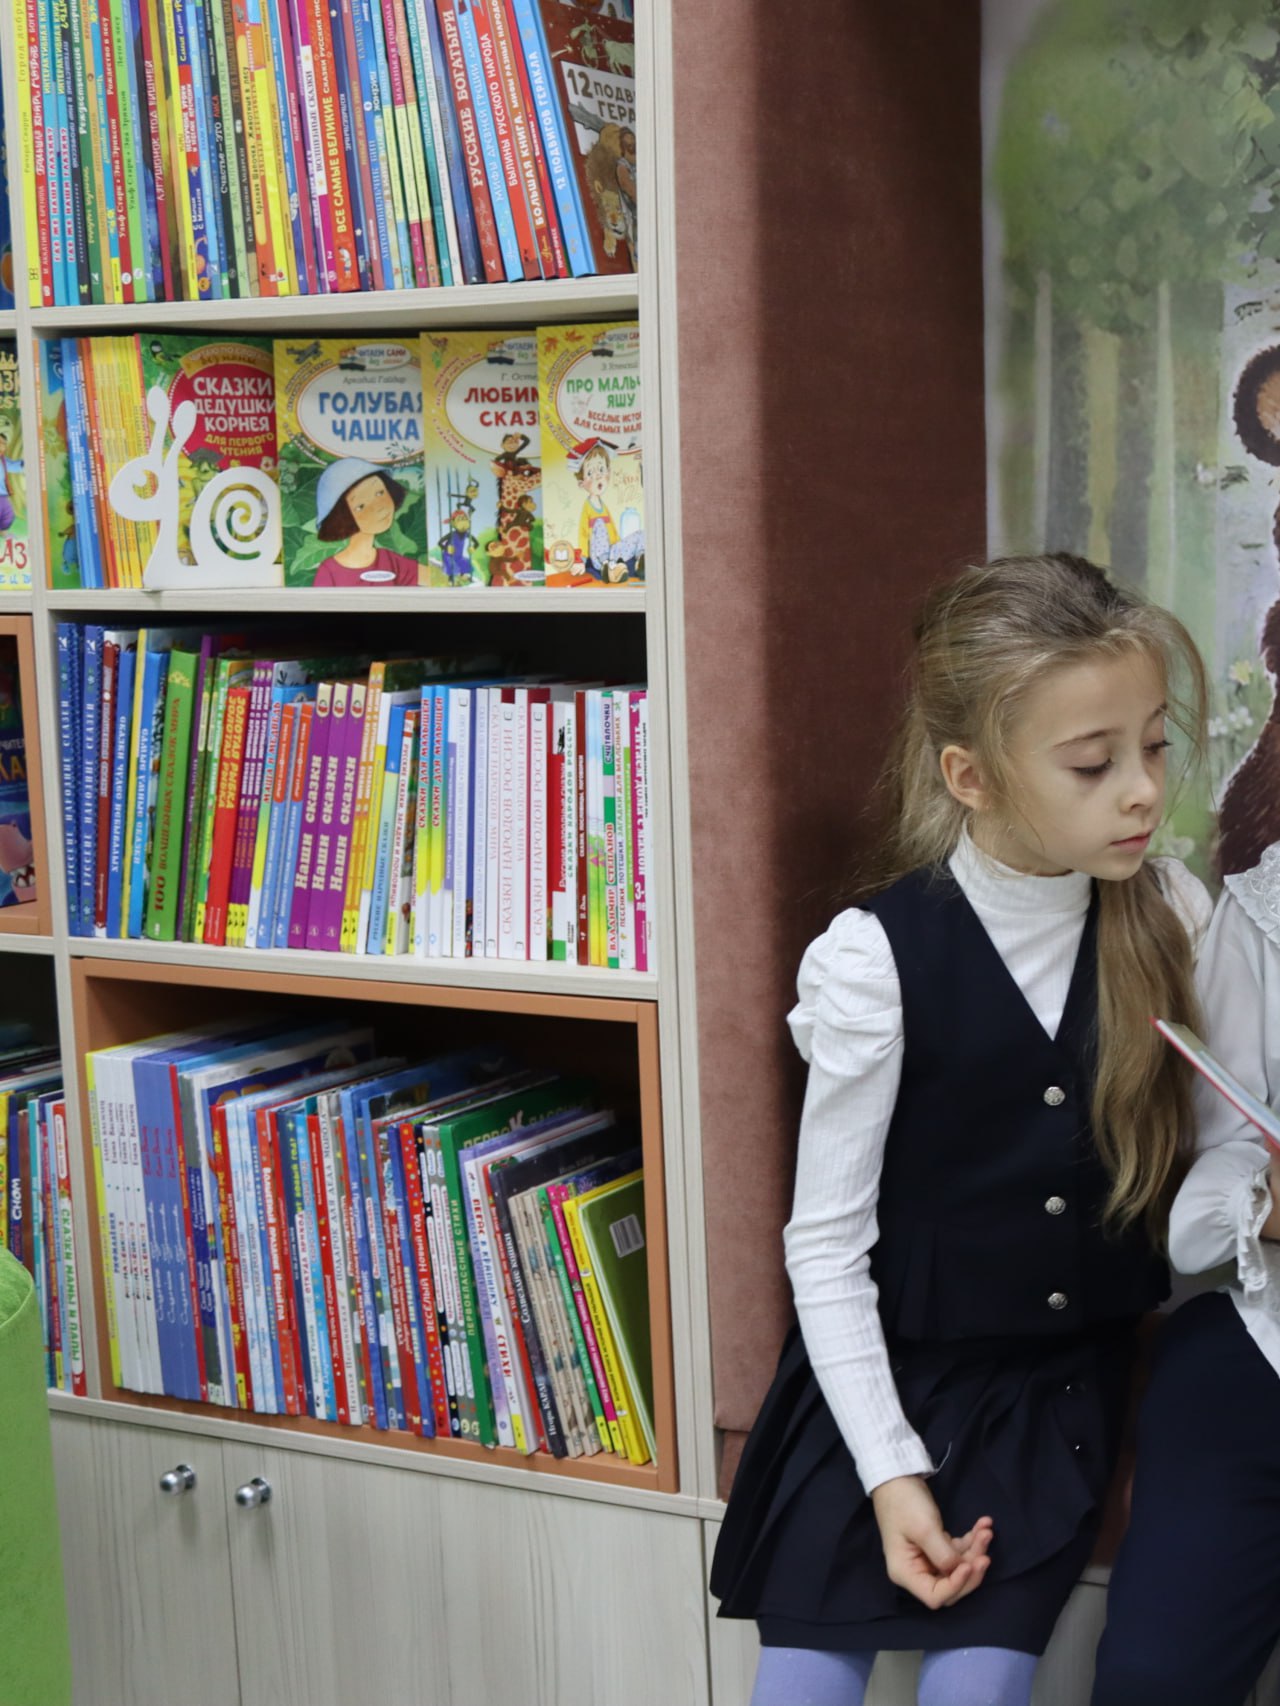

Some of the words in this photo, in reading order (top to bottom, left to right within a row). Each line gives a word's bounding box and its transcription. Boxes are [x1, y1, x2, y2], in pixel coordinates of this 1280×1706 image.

[443, 10, 468, 100] БОГАТЫРИ
[480, 33, 496, 77] НАРОДА
[528, 51, 550, 105] ГЕРАКЛА
[567, 68, 594, 98] 12
[323, 96, 339, 156] ВЕЛИКИЕ
[491, 82, 508, 135] РУССКОГО
[461, 107, 483, 187] РУССКИЕ
[502, 138, 518, 186] БЫЛИНЫ
[541, 109, 564, 172] ПОДВИГОВ
[330, 159, 345, 206] САМЫЕ
[523, 160, 544, 224] БОЛЬШАЯ
[335, 209, 348, 233] ВСЕ
[193, 377, 272, 396] СКАЗКИ
[194, 398, 276, 415] ДЕДУШКИ
[566, 378, 594, 393] ПРО
[607, 394, 636, 408] ЯШУ
[204, 416, 270, 432] КОРНЕЯ
[205, 434, 226, 446] ДЛЯ
[228, 432, 274, 446] ПЕРВОГО
[332, 418, 420, 442] ЧАШКА
[480, 410, 538, 428] СКАЗ
[220, 446, 262, 456] ЧТЕНИЯ
[232, 698, 246, 758] ЗОЛОТАЯ
[420, 699, 430, 756] МАЛЫШЕЙ
[434, 698, 443, 755] МАЛЫШЕЙ
[602, 704, 612, 764] СЧИТАЛОЧКИ
[226, 762, 238, 808] РЫБКА
[262, 772, 272, 804] МАША
[420, 761, 429, 784] ДЛЯ
[432, 760, 442, 783] ДЛЯ
[294, 834, 313, 889] Наши
[305, 755, 322, 823] сказки
[312, 835, 330, 890] Наши
[322, 756, 339, 824] сказки
[331, 835, 348, 891] Наши
[340, 756, 356, 824] сказки
[418, 788, 428, 828] СКАЗКИ
[432, 787, 441, 826] СКАЗКИ
[604, 823, 616, 884] СТЕПАНОВ
[154, 876, 166, 911] 100
[605, 889, 616, 951] ВЛАДИМИР
[12, 1178, 22, 1220] СНОМ
[324, 1165, 334, 1194] ДЕДА
[328, 1199, 338, 1224] ДЛЯ
[414, 1214, 423, 1232] год
[452, 1200, 462, 1236] СТИХИ
[61, 1208, 71, 1260] СКАЗКИ
[331, 1228, 342, 1282] ПОДАРОК
[416, 1236, 428, 1272] Новый
[66, 1264, 76, 1304] МАМЫ
[421, 1278, 434, 1333] ВЕСЁЛЫЙ
[455, 1240, 475, 1336] ПЕРВОКЛАССНЫЕ
[70, 1323, 80, 1360] ПАПЫ
[497, 1334, 511, 1378] СТИХИ
